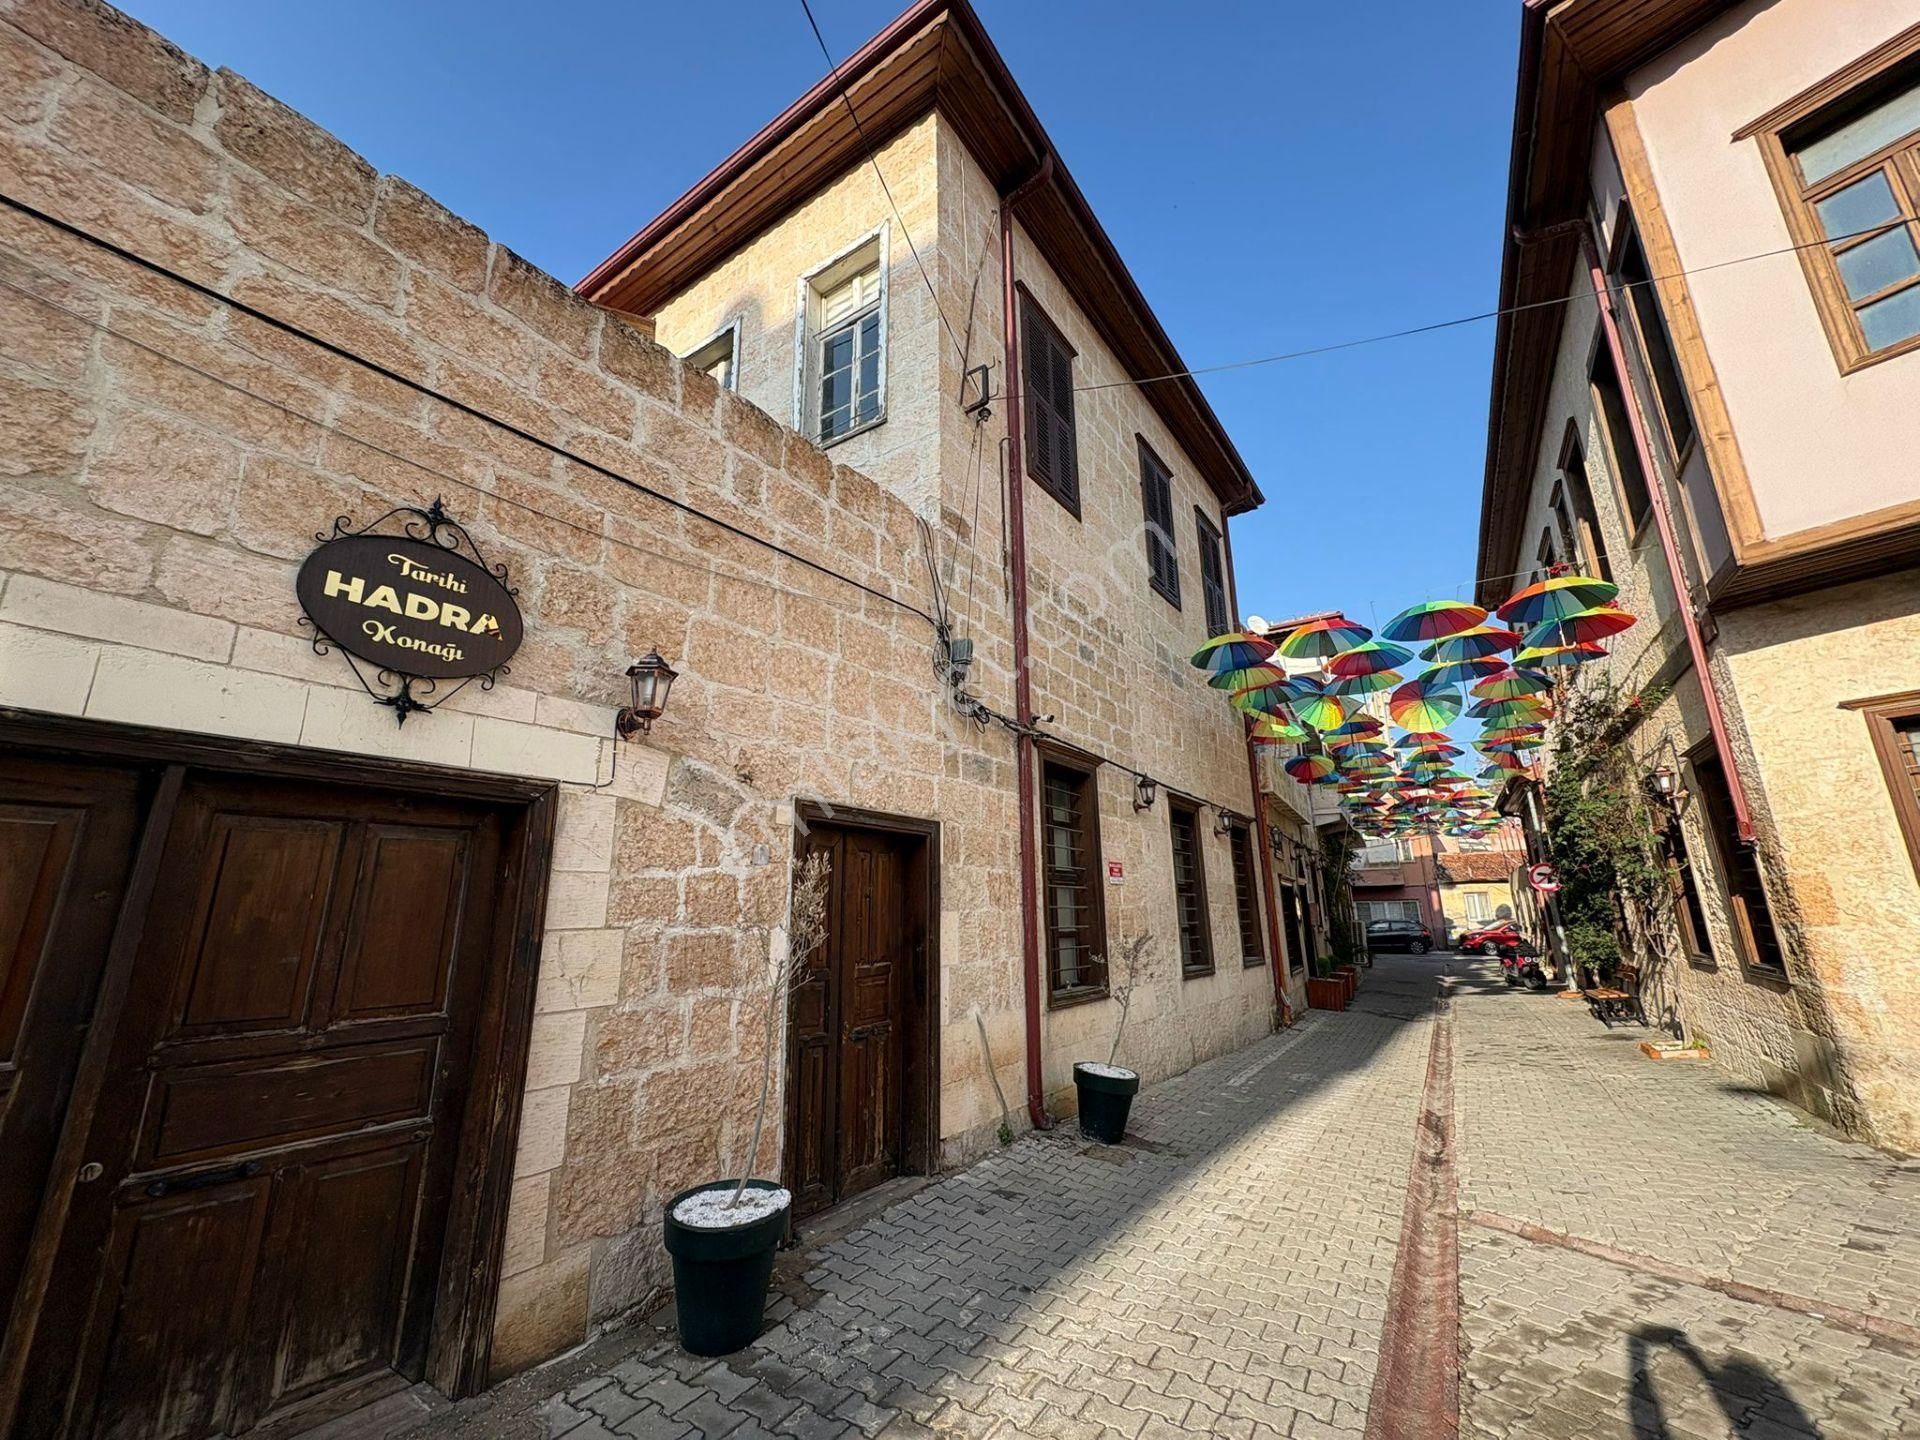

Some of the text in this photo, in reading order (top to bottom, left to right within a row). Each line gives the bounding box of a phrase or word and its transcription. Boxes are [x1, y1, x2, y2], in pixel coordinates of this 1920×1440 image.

[387, 553, 468, 594] Tarihi
[323, 569, 503, 641] HADRA
[362, 619, 465, 662] Konağı
